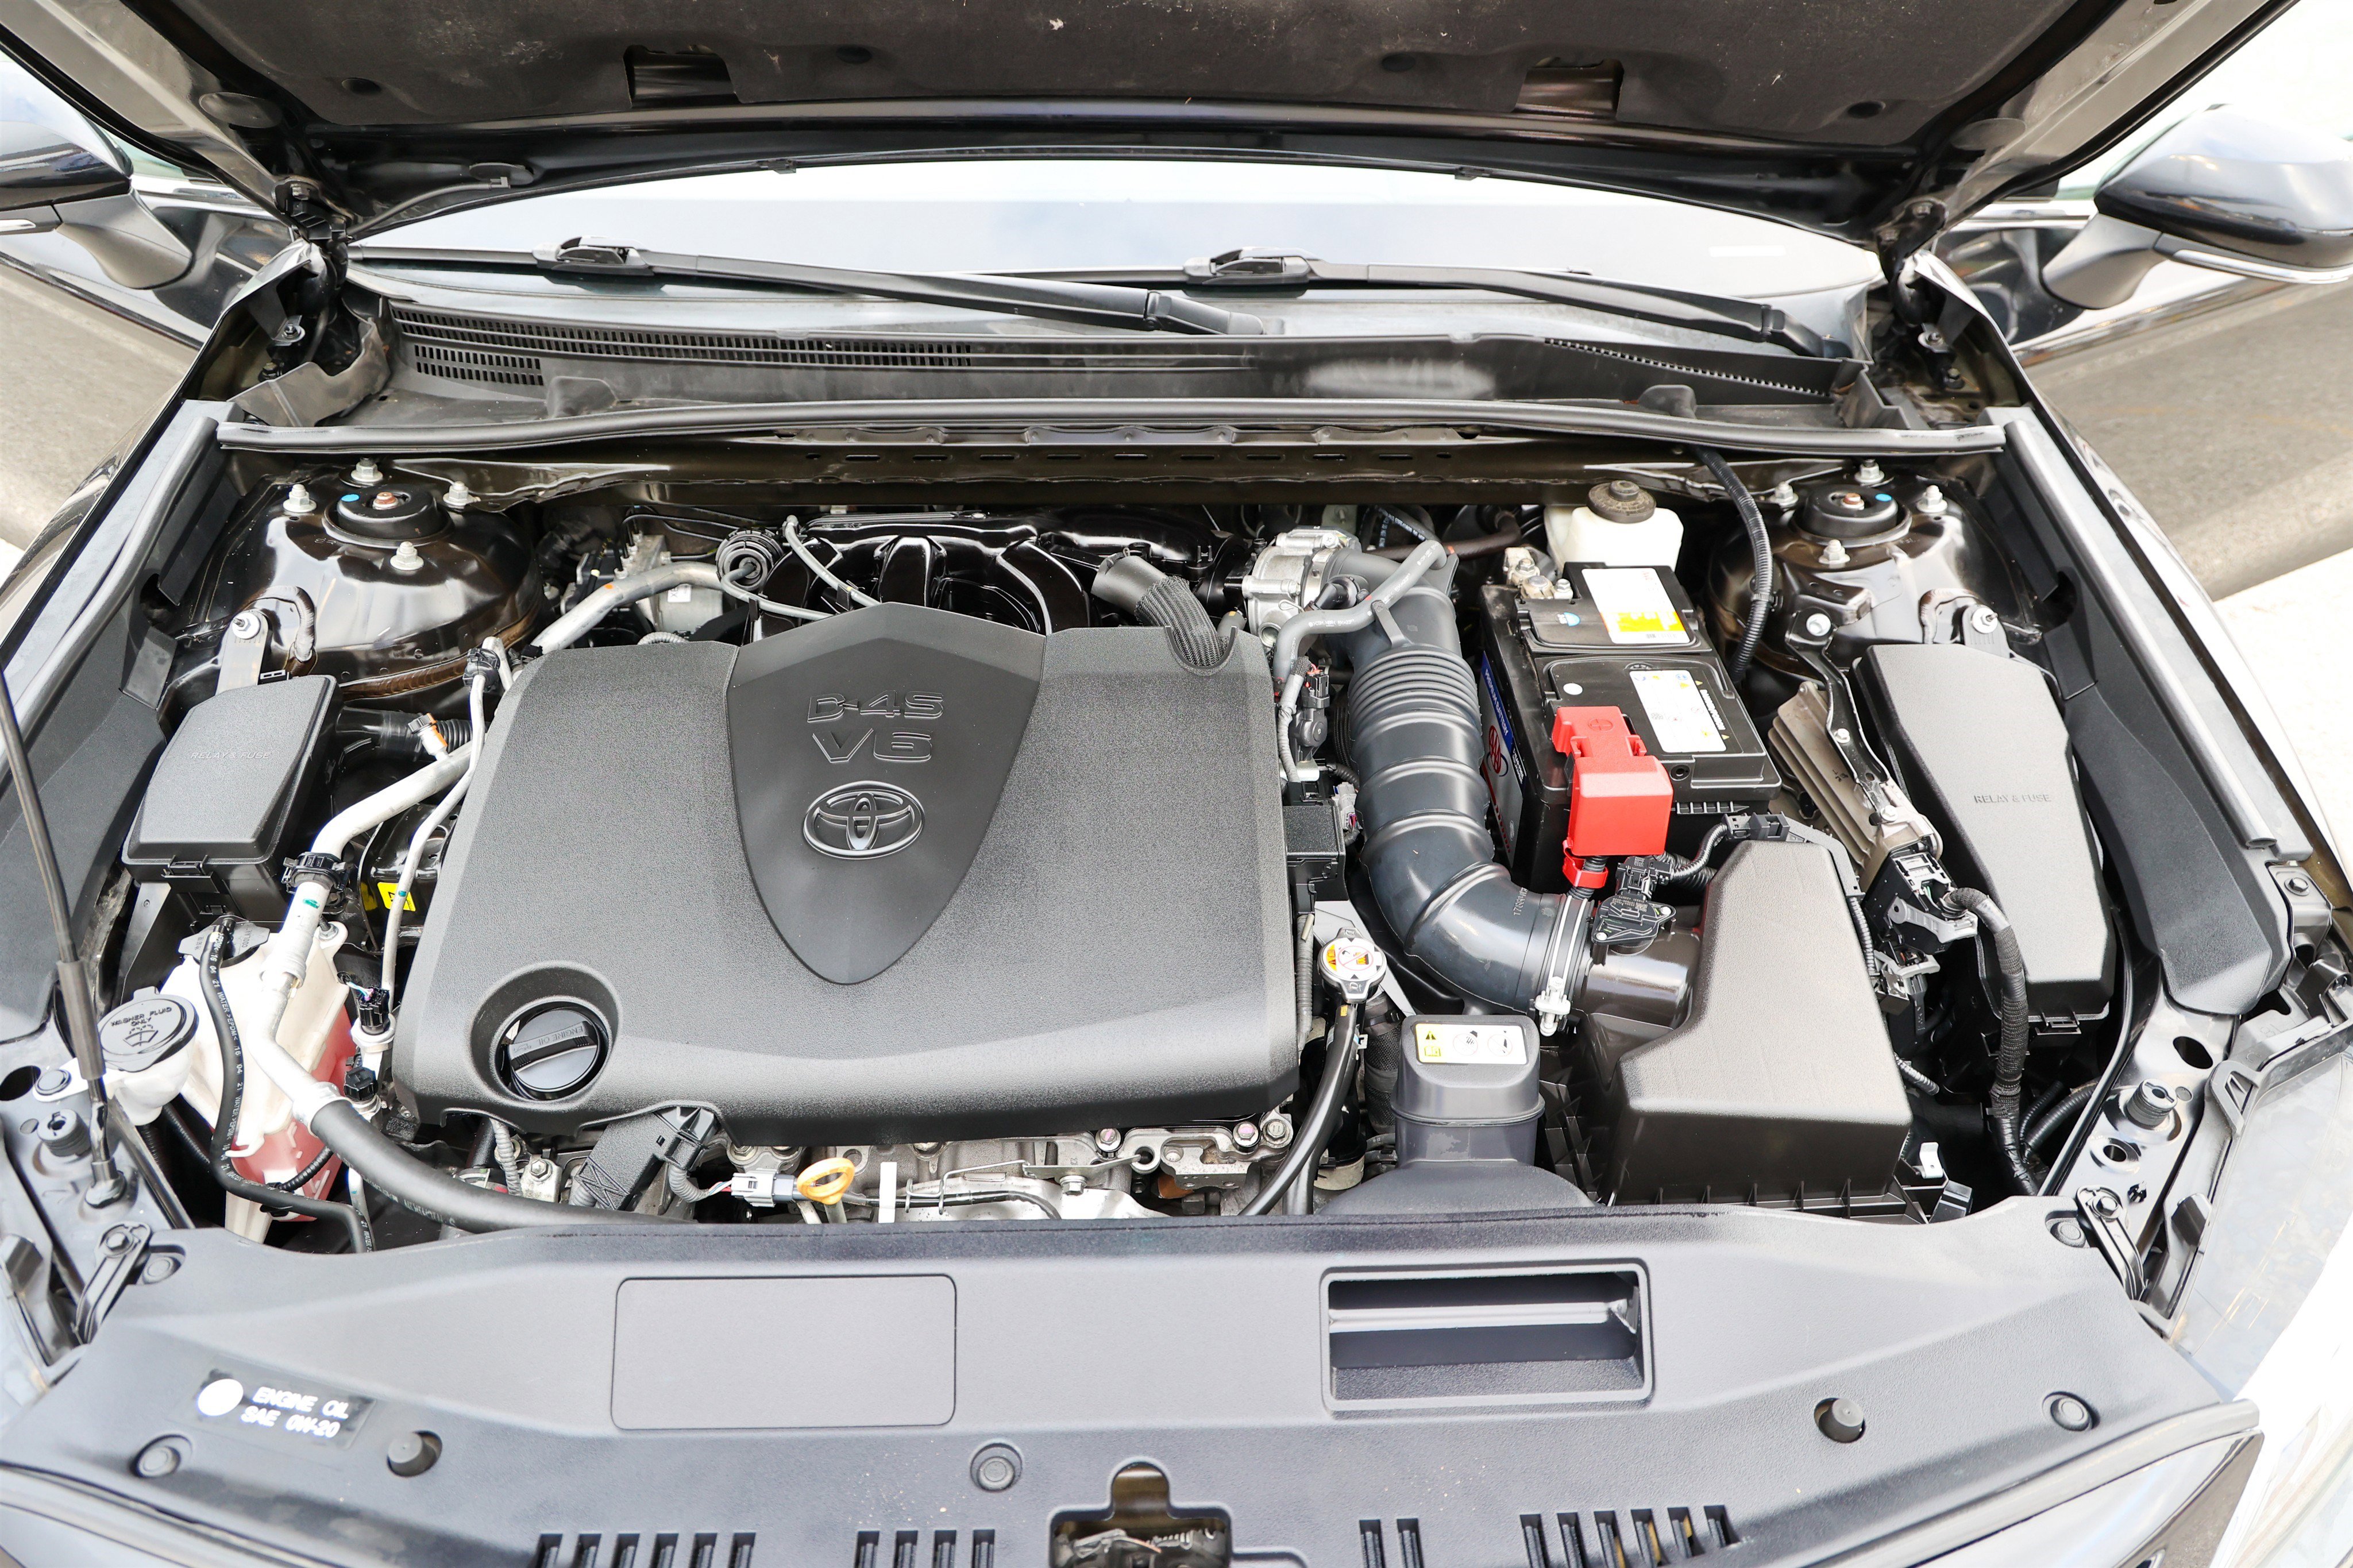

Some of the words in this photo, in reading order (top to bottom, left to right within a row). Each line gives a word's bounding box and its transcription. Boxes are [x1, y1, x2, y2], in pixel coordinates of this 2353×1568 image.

[807, 689, 944, 723] D-4S
[812, 727, 933, 763] V6
[1974, 794, 2009, 803] RELAY
[2022, 794, 2051, 802] FUSE
[212, 979, 220, 988] 21
[217, 991, 230, 1013] WATER
[111, 1013, 145, 1027] WASHER
[149, 1006, 172, 1016] FLUID
[130, 1017, 152, 1027] ONLY
[552, 1026, 583, 1040] ENGINE
[538, 1037, 550, 1045] OIL
[234, 1045, 241, 1056] 16
[237, 1082, 244, 1091] 21
[232, 1095, 241, 1117] WATER
[221, 1163, 230, 1172] 21
[252, 1387, 318, 1413] ENGINE
[322, 1400, 349, 1419] OIL
[240, 1405, 281, 1428] SAE
[285, 1414, 341, 1439] 0W-20
